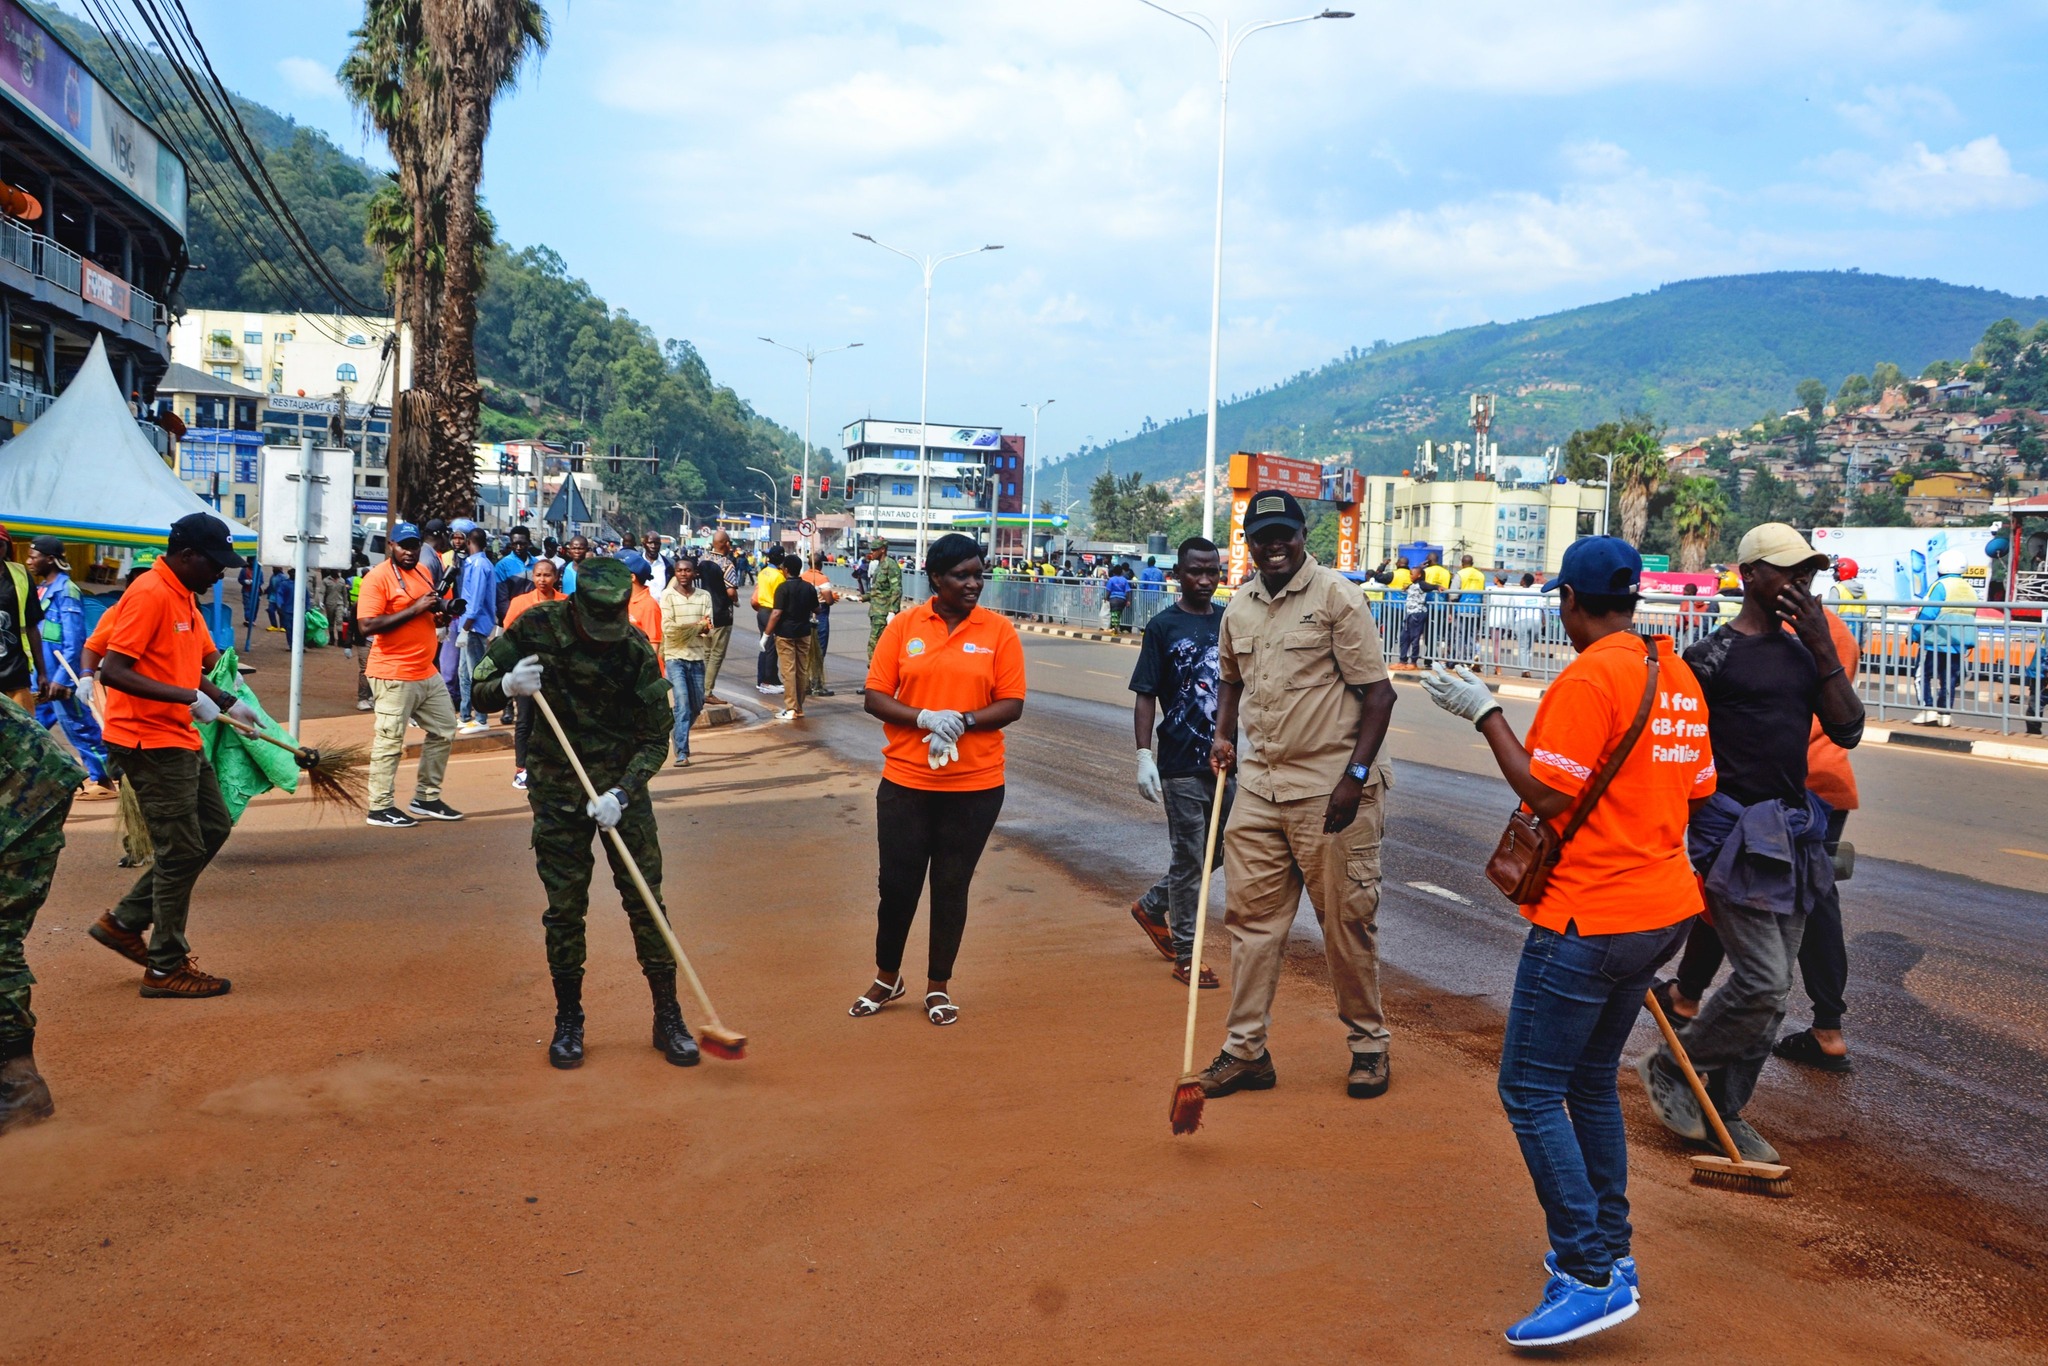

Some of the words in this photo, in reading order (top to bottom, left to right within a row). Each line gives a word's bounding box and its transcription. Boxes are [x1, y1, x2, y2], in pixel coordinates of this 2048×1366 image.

[272, 397, 325, 411] RESTAURANT
[333, 405, 349, 413] BR
[1671, 692, 1698, 711] for
